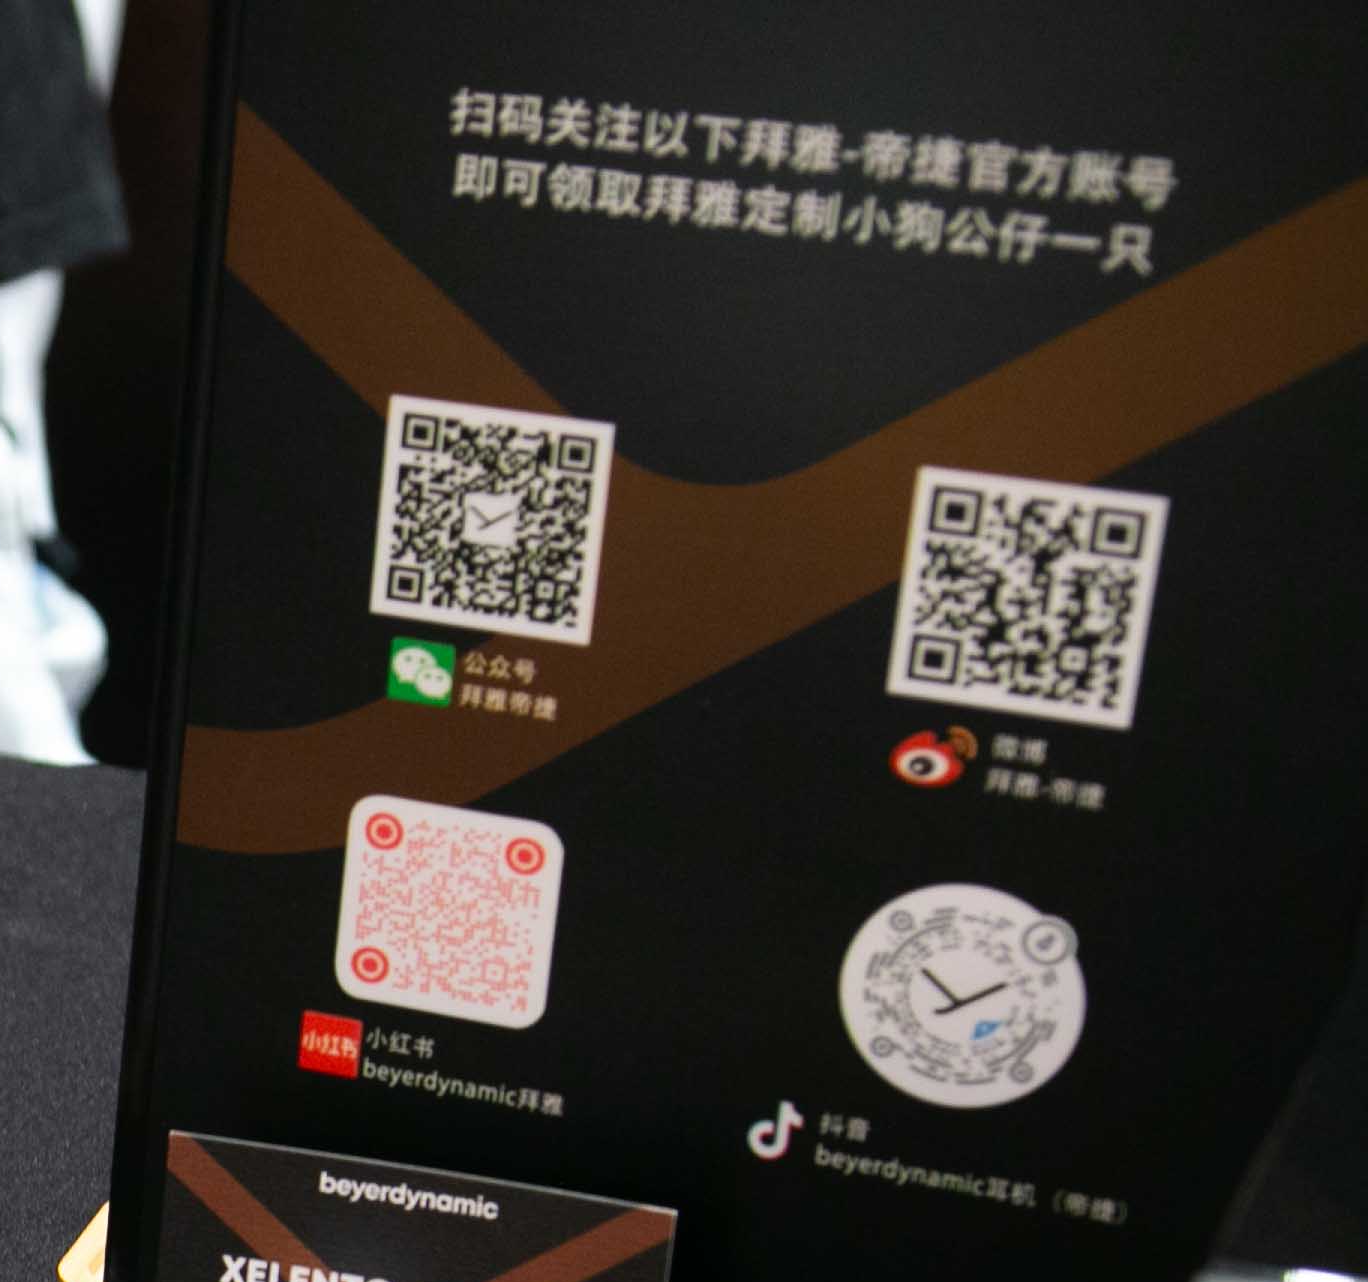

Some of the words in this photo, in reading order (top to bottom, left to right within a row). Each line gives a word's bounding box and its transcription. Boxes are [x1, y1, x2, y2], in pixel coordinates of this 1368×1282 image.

[450, 87, 1178, 211] 扫码关注以下拜雅-帝捷官方账号
[452, 154, 1156, 278] 即可领取拜雅定制小狗公仔一只
[464, 652, 536, 685] 公众号
[365, 1027, 436, 1060] 小红书
[820, 1112, 872, 1143] 抖音
[318, 1170, 500, 1221] beyerdynamic
